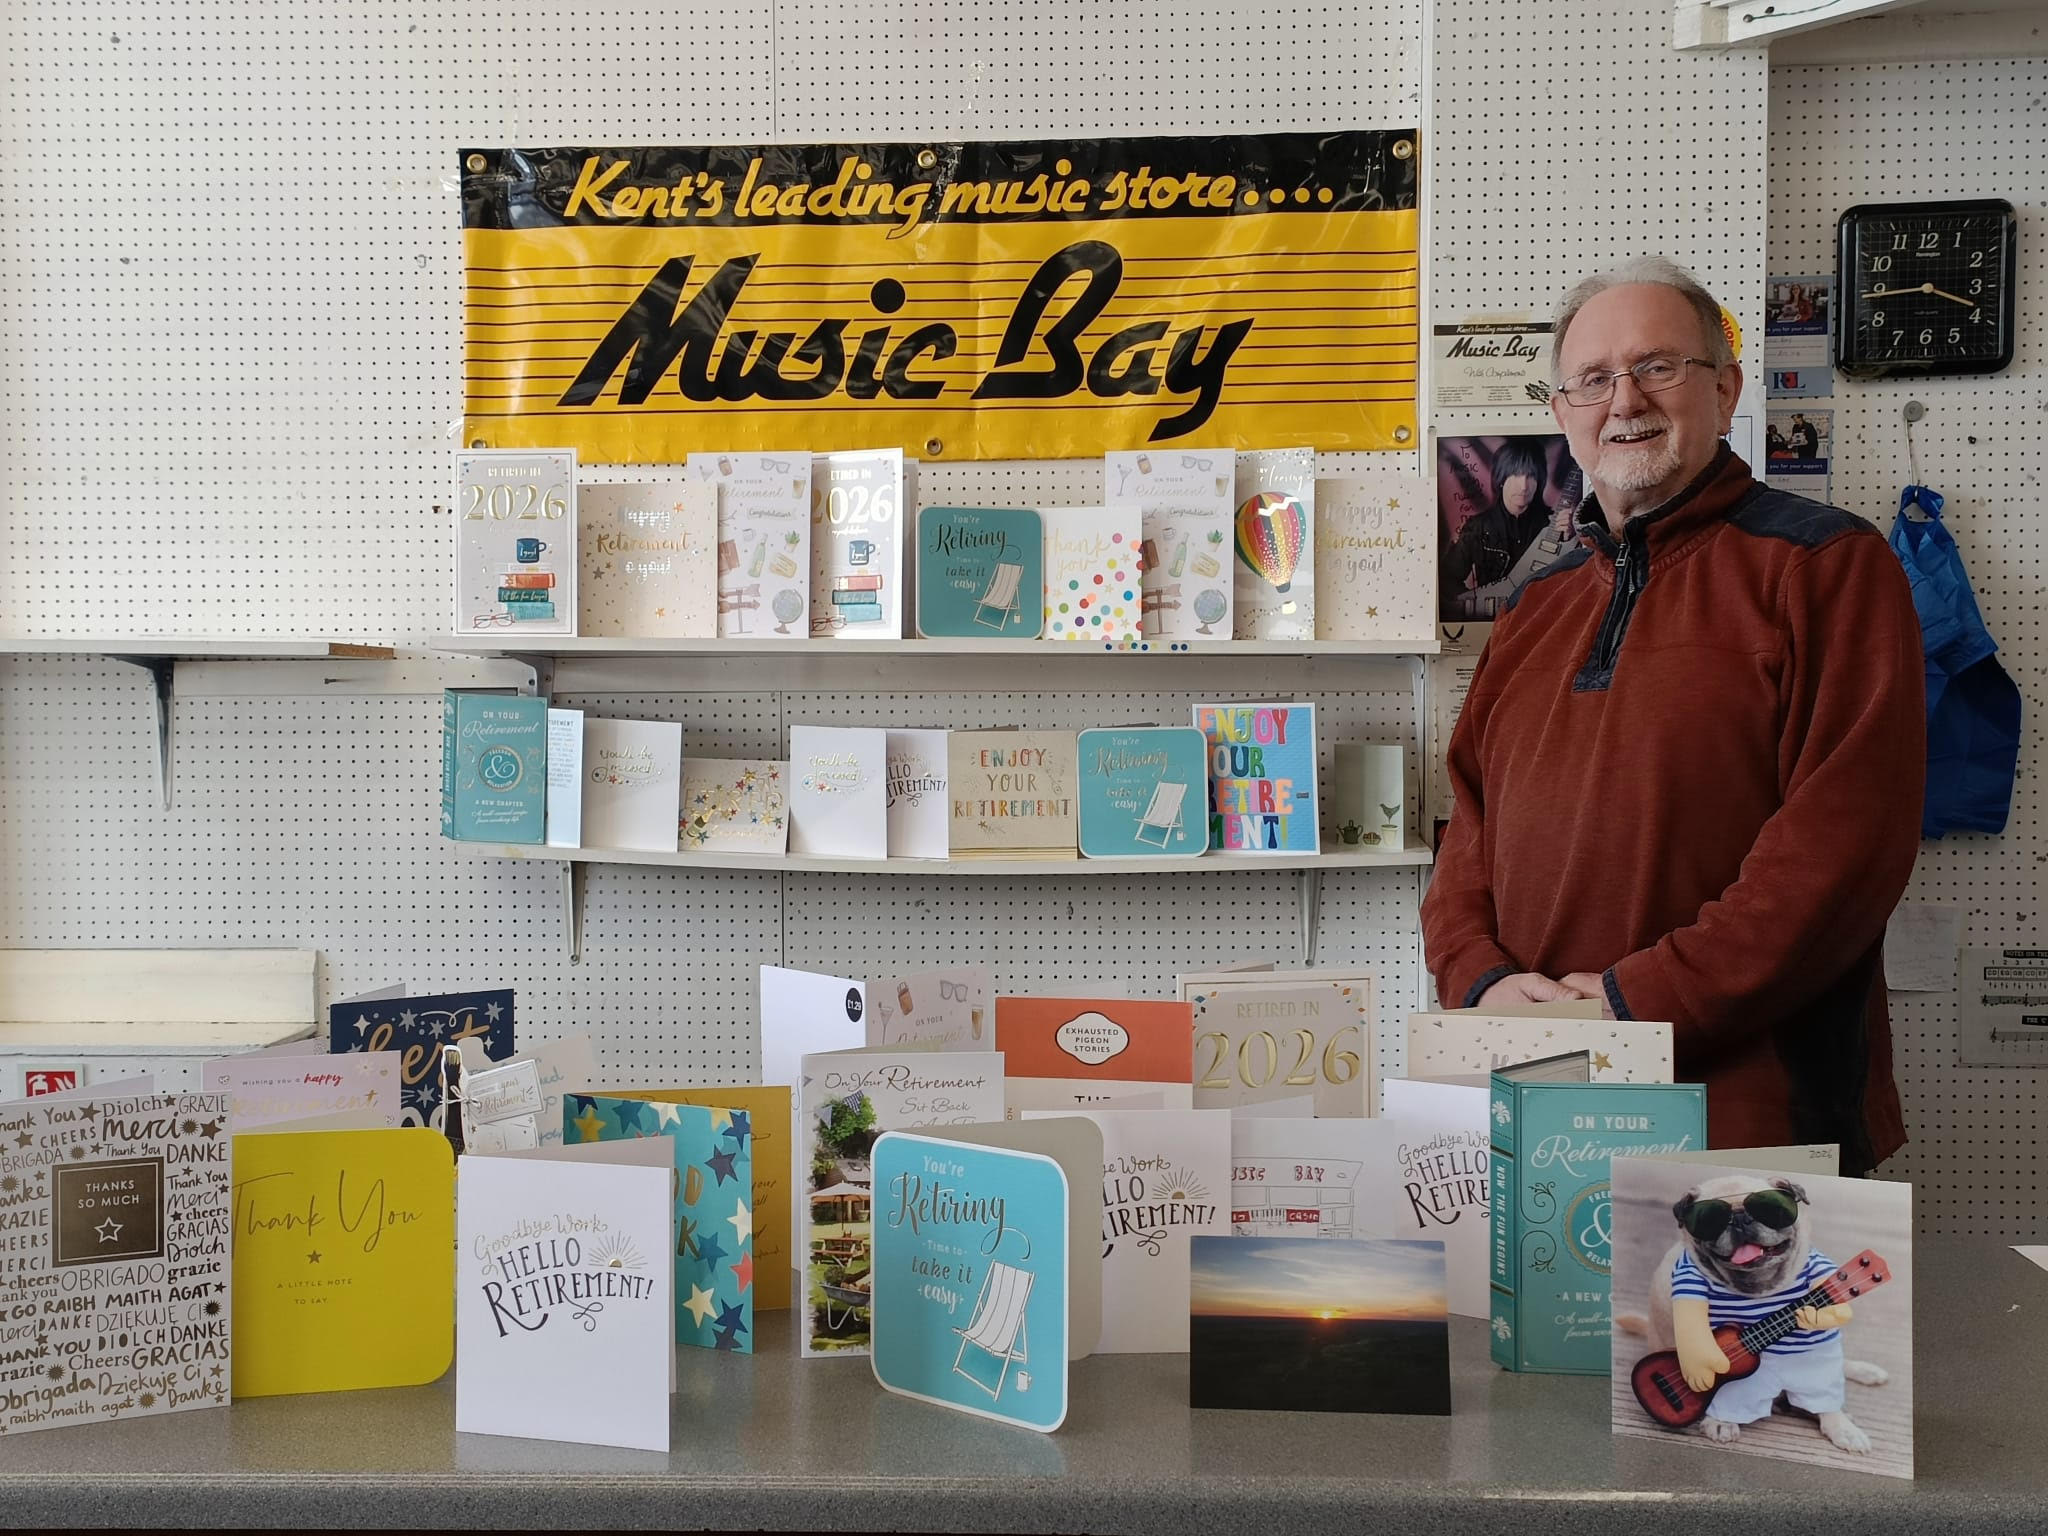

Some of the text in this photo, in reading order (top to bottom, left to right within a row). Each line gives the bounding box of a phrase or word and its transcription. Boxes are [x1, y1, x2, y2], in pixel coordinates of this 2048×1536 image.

[564, 156, 724, 218] Kent's
[735, 156, 933, 240] leading
[939, 158, 1089, 214] music
[1892, 234, 1908, 250] 11
[1918, 233, 1939, 249] 12
[1952, 232, 1963, 248] 1
[1871, 256, 1892, 272] 10
[1969, 251, 1983, 268] 2
[1969, 278, 1982, 295] 3
[1872, 312, 1885, 327] 8
[1968, 308, 1982, 323] 4
[556, 240, 1256, 442] Music Bay
[1892, 330, 1904, 346] 7
[1919, 329, 1933, 345] 6
[1948, 328, 1960, 343] 5
[1446, 335, 1541, 362] Music Bay
[1134, 484, 1209, 499] Retirement
[463, 484, 567, 520] 2026
[953, 513, 980, 525] You're
[596, 531, 693, 556] Retirement
[929, 523, 1022, 561] Retiring
[945, 564, 986, 577] take it
[952, 580, 977, 593] easy
[462, 720, 540, 743] Retirement
[1200, 707, 1289, 745] ENJOY
[1112, 736, 1140, 746] You're
[980, 748, 1047, 768] ENJOY
[1089, 746, 1185, 780] Retiring
[987, 774, 1037, 793] YOUR
[1107, 786, 1133, 798] take
[954, 799, 1072, 818] RETIREMENT
[1114, 799, 1138, 814] easy
[1208, 814, 1288, 850] MENT!
[1237, 1001, 1320, 1018] RETIRED IN
[915, 1016, 944, 1026] ON YOUR
[1066, 1027, 1119, 1036] EXHAUSTED
[1074, 1045, 1111, 1053] STORIES
[1196, 1026, 1361, 1089] 2026
[304, 1073, 343, 1088] happy
[501, 1079, 521, 1091] your
[825, 1064, 987, 1093] On Your Retirement
[102, 1095, 163, 1118] Diolch
[178, 1095, 229, 1114] GRAZIE
[484, 1093, 527, 1113] Retirement
[900, 1096, 971, 1115] Sit Back
[43, 1107, 76, 1127] You
[102, 1112, 182, 1142] Merci
[1574, 1116, 1649, 1130] ON YOUR
[40, 1126, 97, 1149] CHEERS
[104, 1142, 161, 1158] Thank You
[166, 1142, 229, 1164] DANKE
[1397, 1131, 1491, 1178] Goodbye Wo
[1531, 1134, 1693, 1178] Retirement
[1808, 1150, 1834, 1159] 2026
[0, 1148, 64, 1174] BRIGADA
[923, 1155, 965, 1178] You're
[1118, 1154, 1171, 1175] Work
[1417, 1149, 1488, 1185] HELLO
[85, 1180, 135, 1193] THANKS
[166, 1170, 228, 1191] Thank You
[78, 1194, 140, 1209] SO MUCH
[1103, 1176, 1145, 1208] LLO
[1404, 1177, 1491, 1229] RETIRE
[185, 1206, 229, 1222] cheers
[232, 1169, 423, 1260] Thank You
[888, 1171, 1031, 1261] Retiring
[1497, 1192, 1507, 1235] THE FUN
[166, 1216, 229, 1242] GRACIAS
[167, 1236, 226, 1263] Diolch
[474, 1213, 608, 1276] Goodbye Work
[927, 1239, 964, 1257] Time to
[497, 1237, 581, 1283] HELLO
[61, 1262, 165, 1292] OBRIGADO
[167, 1257, 222, 1285] grazie
[912, 1256, 973, 1285] take it
[8, 1272, 60, 1290] cheers
[289, 1280, 323, 1288] LITTLE
[11, 1282, 212, 1321] GO RAIBH MAITH AGAT
[31, 1288, 58, 1302] you
[482, 1272, 654, 1338] RETIREMENT!
[923, 1282, 957, 1314] easy
[1563, 1291, 1601, 1302] A NEW
[187, 1302, 202, 1321] CI
[38, 1314, 93, 1332] DANKE
[170, 1318, 229, 1344] DANKE
[53, 1338, 91, 1357] YOU
[98, 1331, 166, 1351] DIOLCH
[68, 1353, 130, 1371] Cheers
[131, 1338, 229, 1370] GRACIAS
[183, 1363, 202, 1382] Ci
[168, 1377, 229, 1408] Danke
[9, 1397, 135, 1425] raibh maith agat
